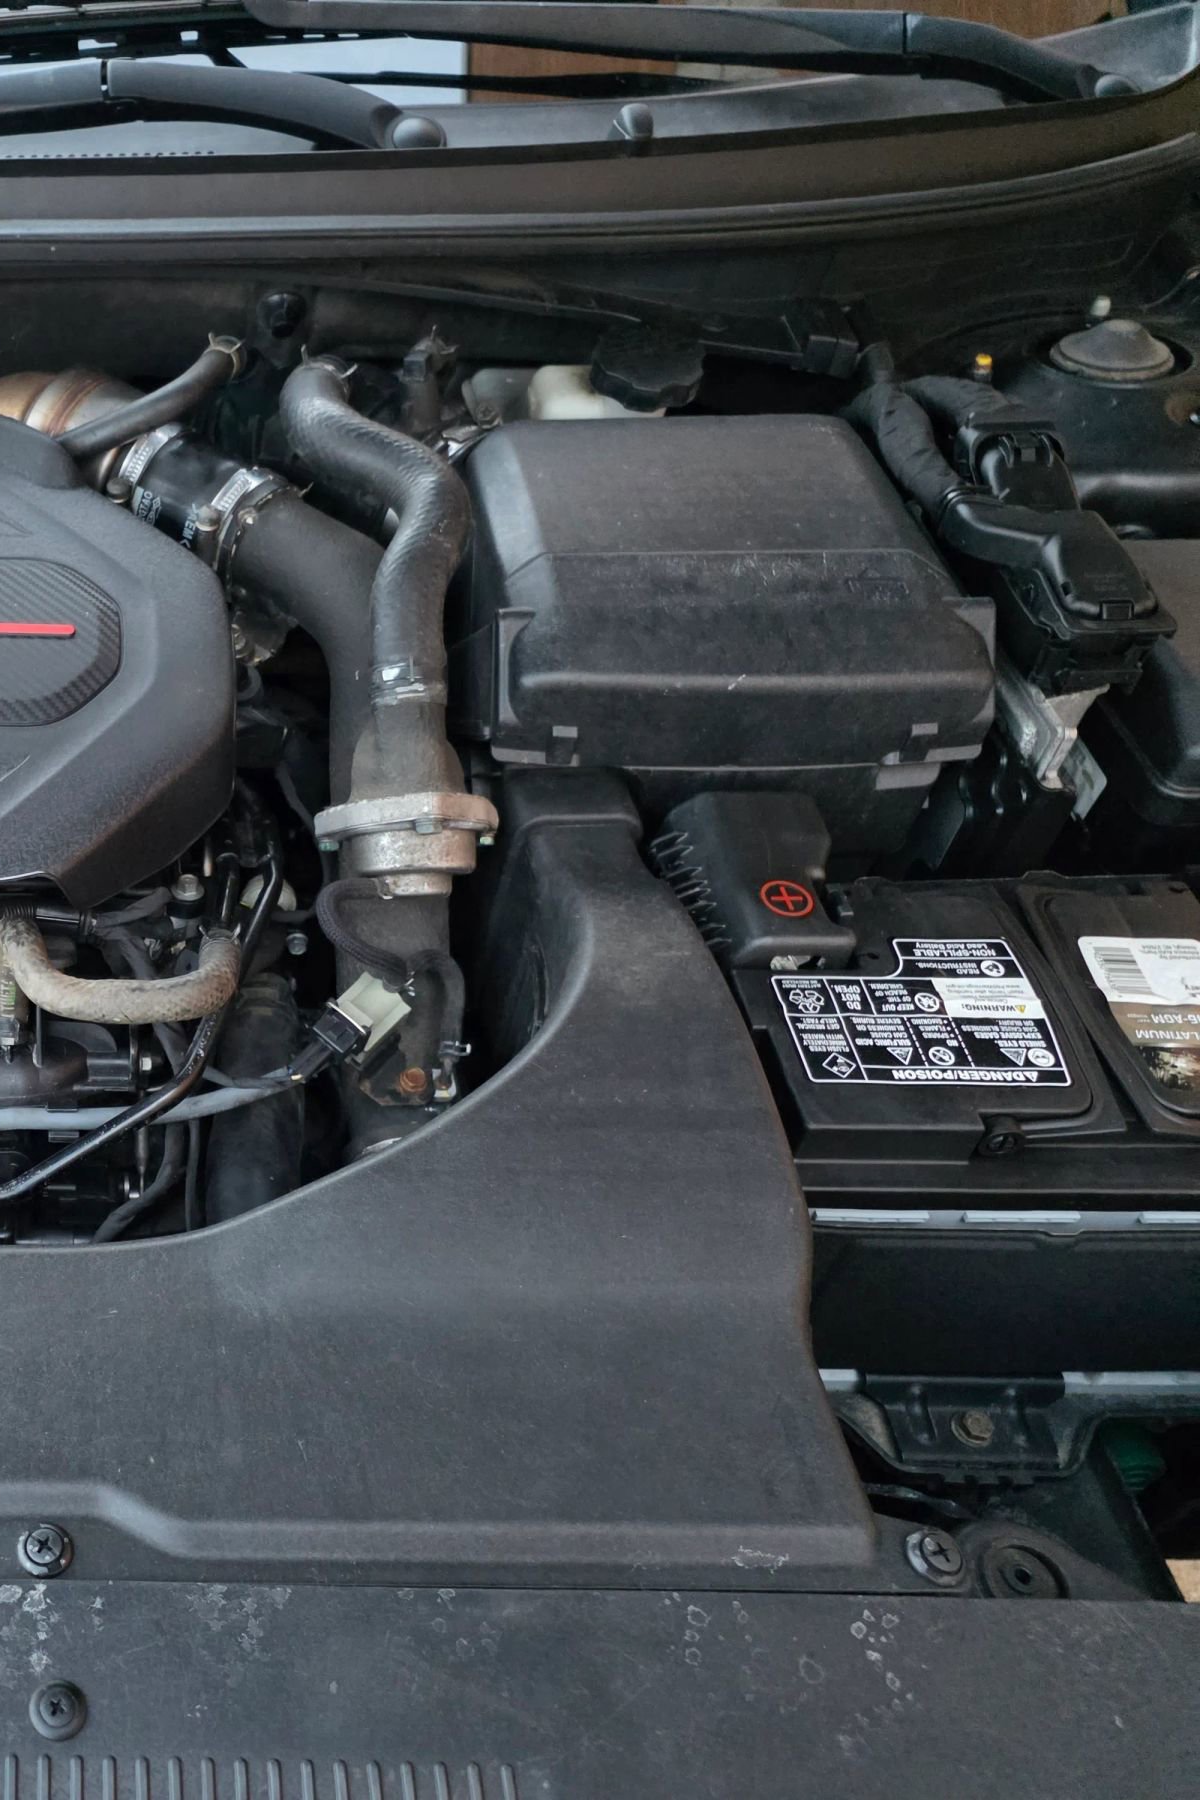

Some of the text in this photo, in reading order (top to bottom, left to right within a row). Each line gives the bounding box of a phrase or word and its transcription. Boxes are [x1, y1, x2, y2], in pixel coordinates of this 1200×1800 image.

[912, 948, 996, 956] NON-SPILLABLE
[830, 985, 861, 993] OPEN.
[840, 993, 861, 1001] NOT
[845, 1002, 861, 1010] DO
[961, 1004, 1016, 1012] WARNING:
[1135, 1030, 1200, 1040] LATINUM
[855, 1038, 874, 1046] ACID
[891, 1070, 1026, 1081] DANGER/POISON
